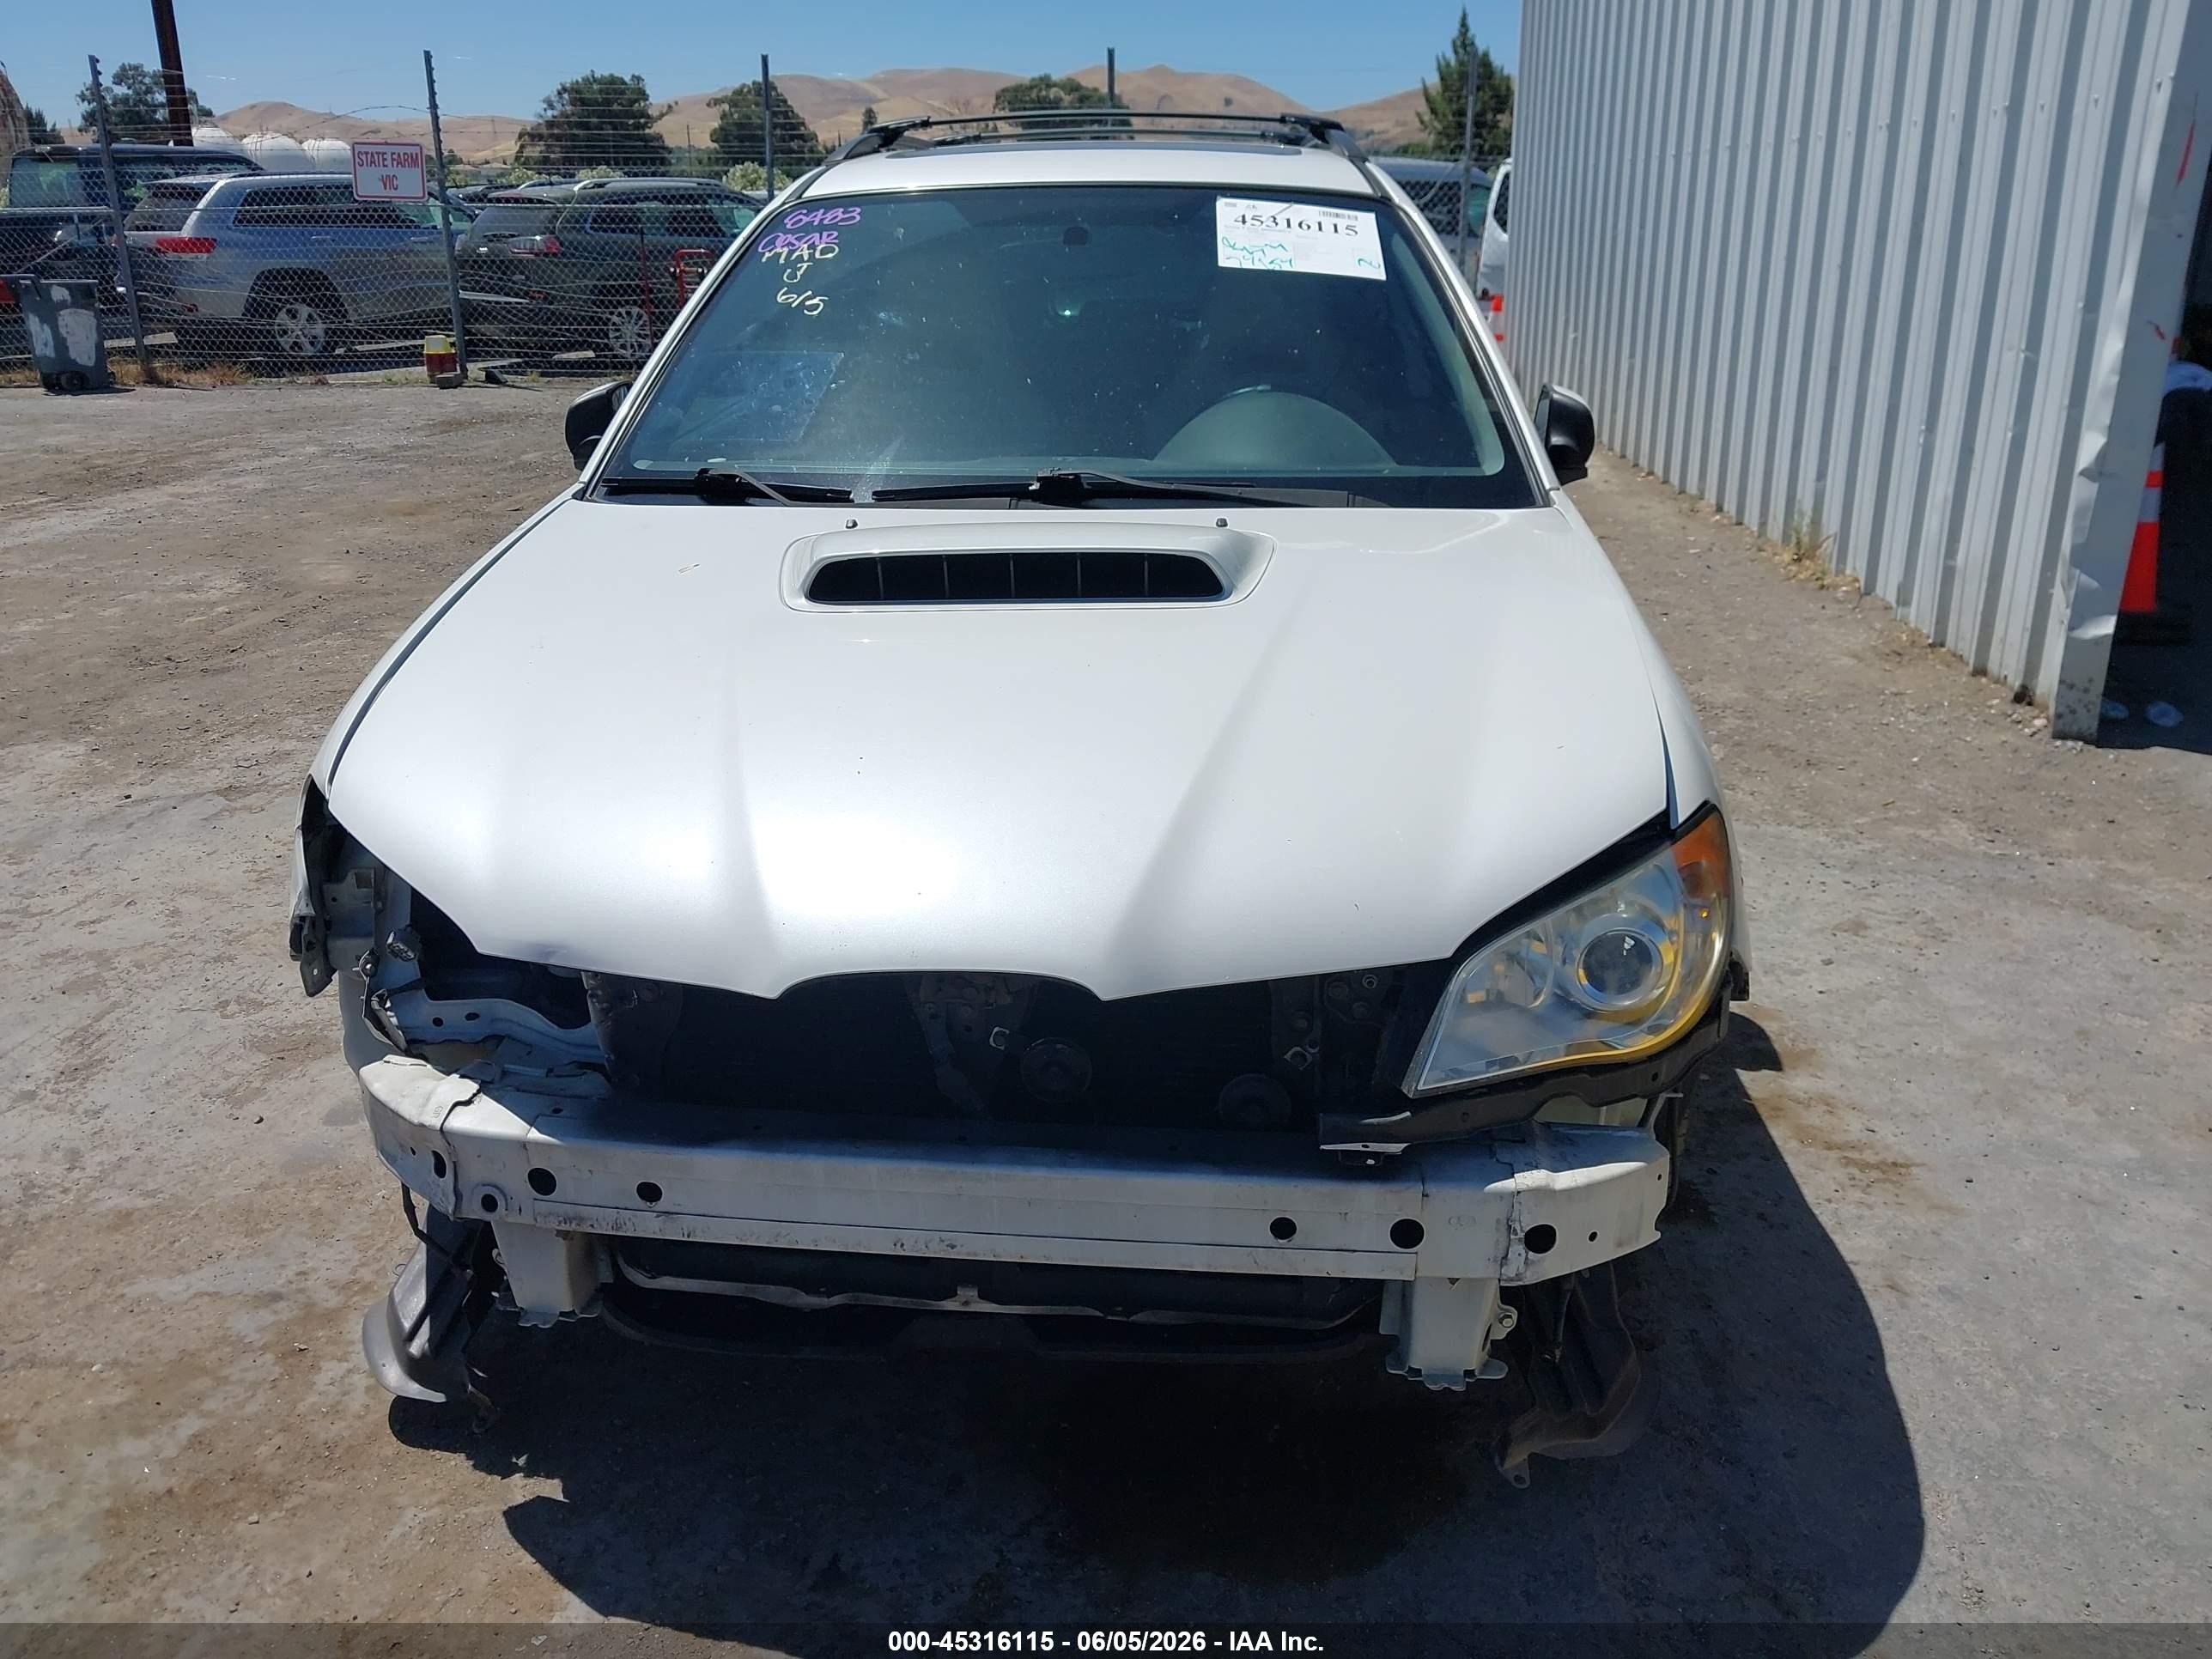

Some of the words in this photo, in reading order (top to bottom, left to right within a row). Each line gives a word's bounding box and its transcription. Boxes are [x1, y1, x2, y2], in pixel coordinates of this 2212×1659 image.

[356, 150, 388, 168] STATE
[391, 152, 420, 169] FARM
[380, 174, 398, 191] VIC
[1234, 214, 1358, 236] 45316115
